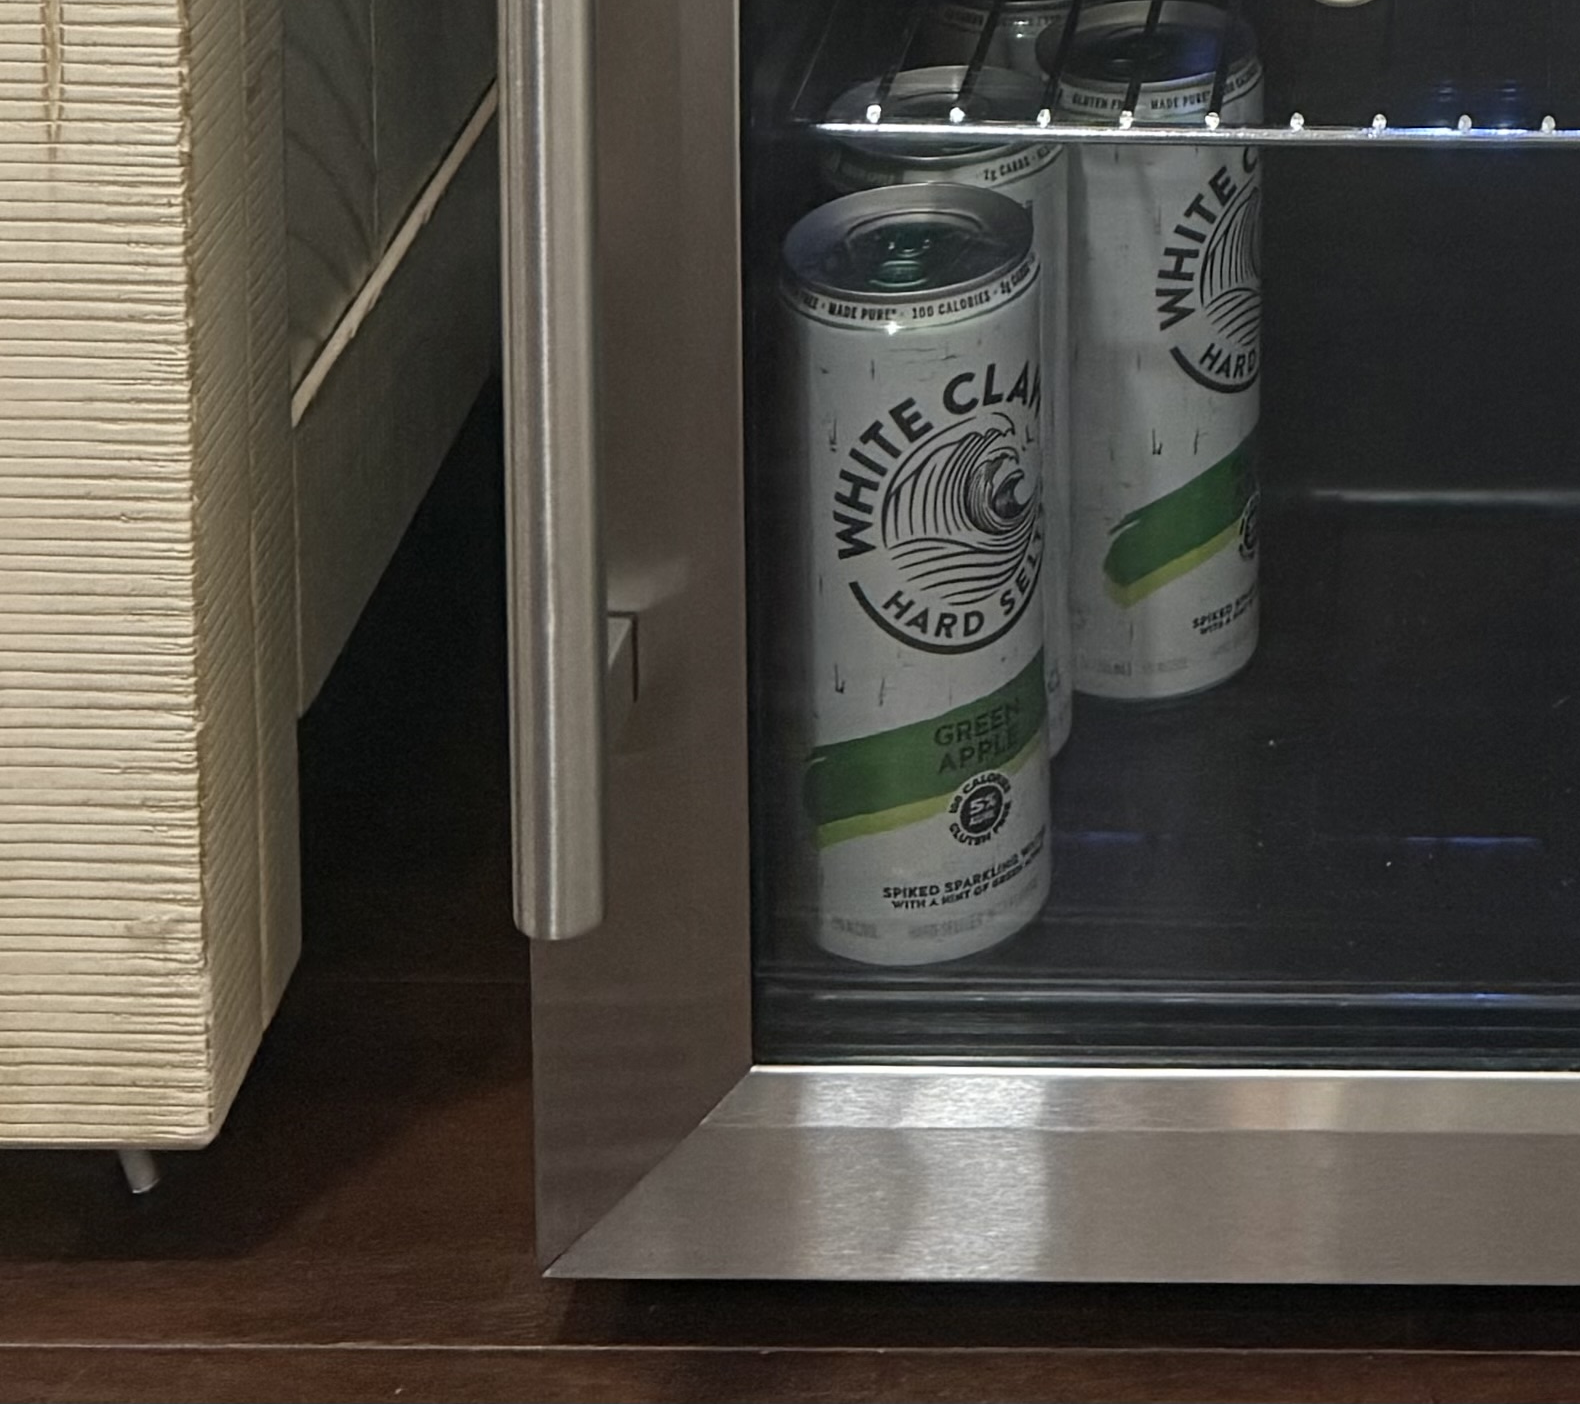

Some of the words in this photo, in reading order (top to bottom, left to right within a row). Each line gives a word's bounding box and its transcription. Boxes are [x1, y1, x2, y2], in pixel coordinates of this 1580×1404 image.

[1150, 96, 1179, 110] MADE
[1154, 164, 1238, 332] WHITE
[828, 301, 857, 319] MADE
[911, 305, 935, 320] 100
[938, 290, 992, 316] CALORIES
[1198, 342, 1256, 380] HARD
[832, 397, 934, 560] WHITE
[882, 590, 985, 639] HARD
[933, 697, 1020, 747] GREEN
[938, 727, 1017, 775] APPLE
[882, 884, 941, 900] SPIKED
[890, 899, 927, 911] WITH
